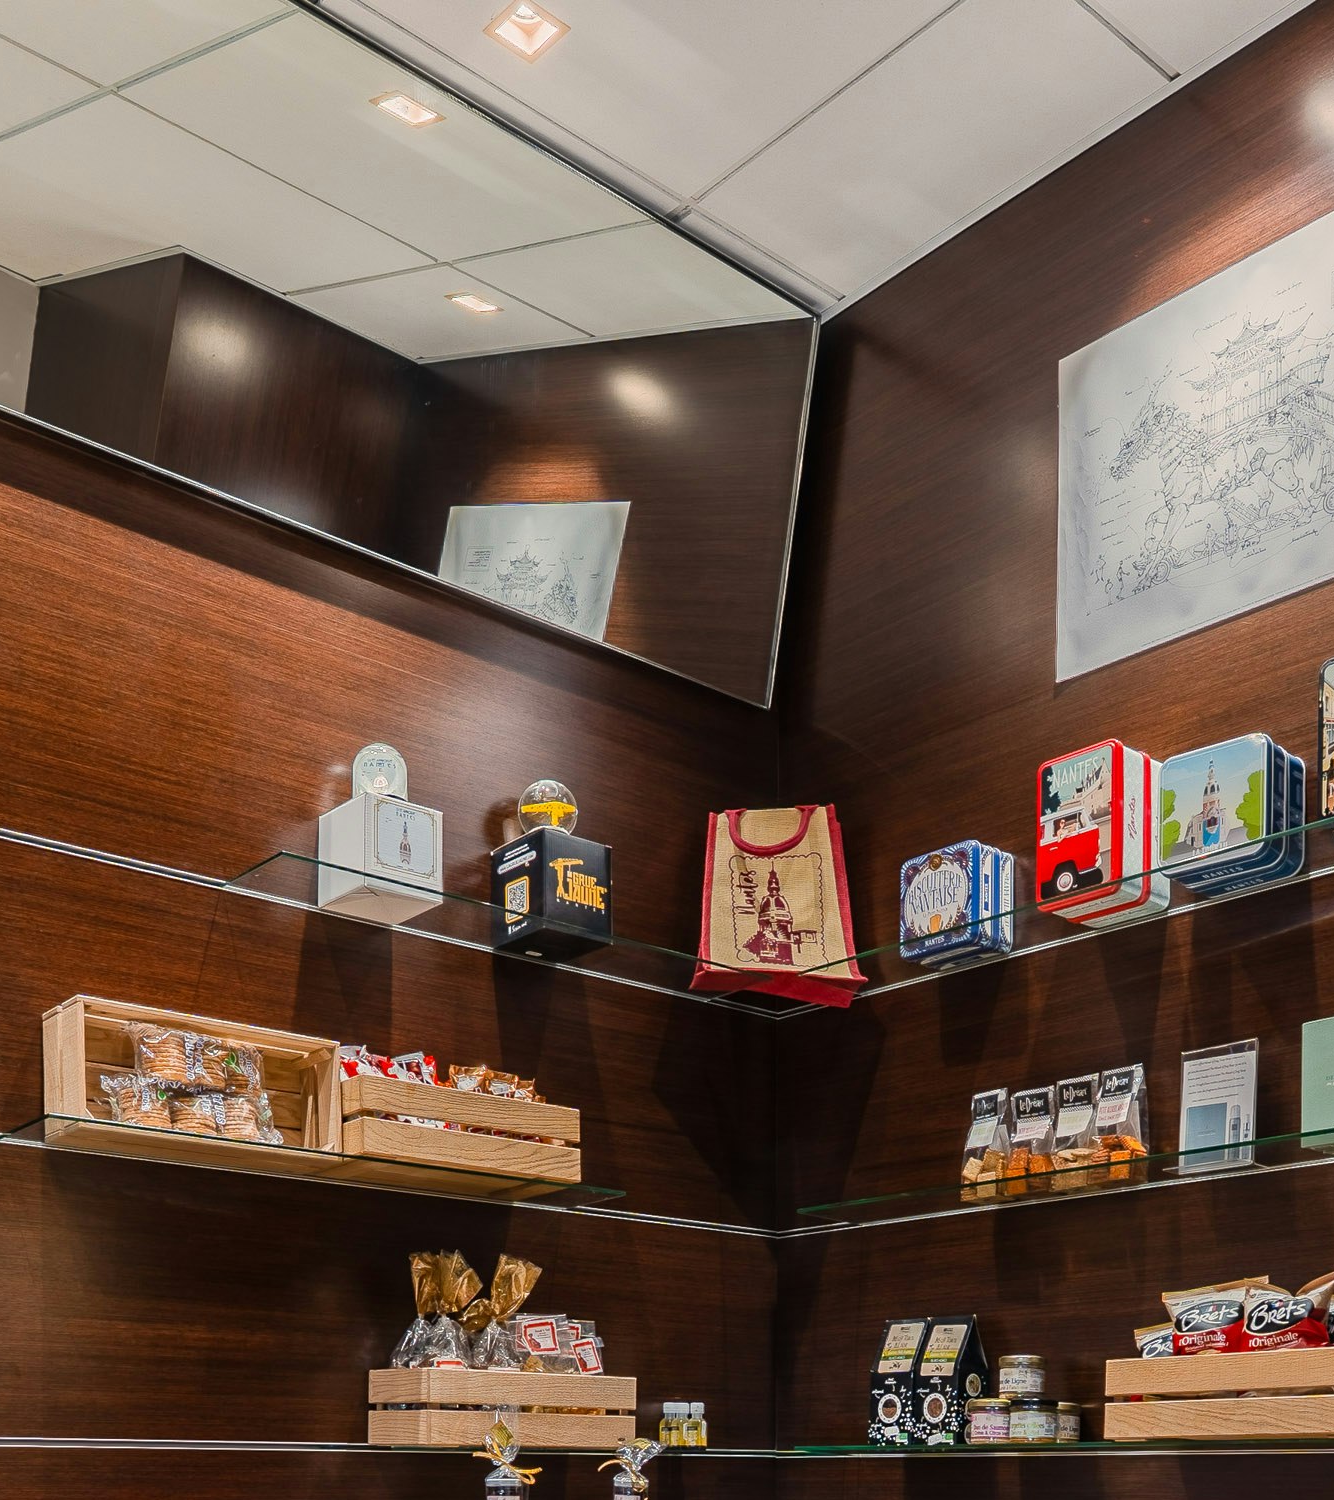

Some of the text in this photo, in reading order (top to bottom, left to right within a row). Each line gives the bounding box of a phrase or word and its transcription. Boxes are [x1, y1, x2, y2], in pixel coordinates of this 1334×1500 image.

[1051, 756, 1100, 790] NANTES
[572, 871, 597, 888] GRUE
[1202, 866, 1244, 881] NANTES
[740, 868, 759, 918] Nantes
[1224, 878, 1265, 893] NANTES
[924, 935, 945, 948] NANTES
